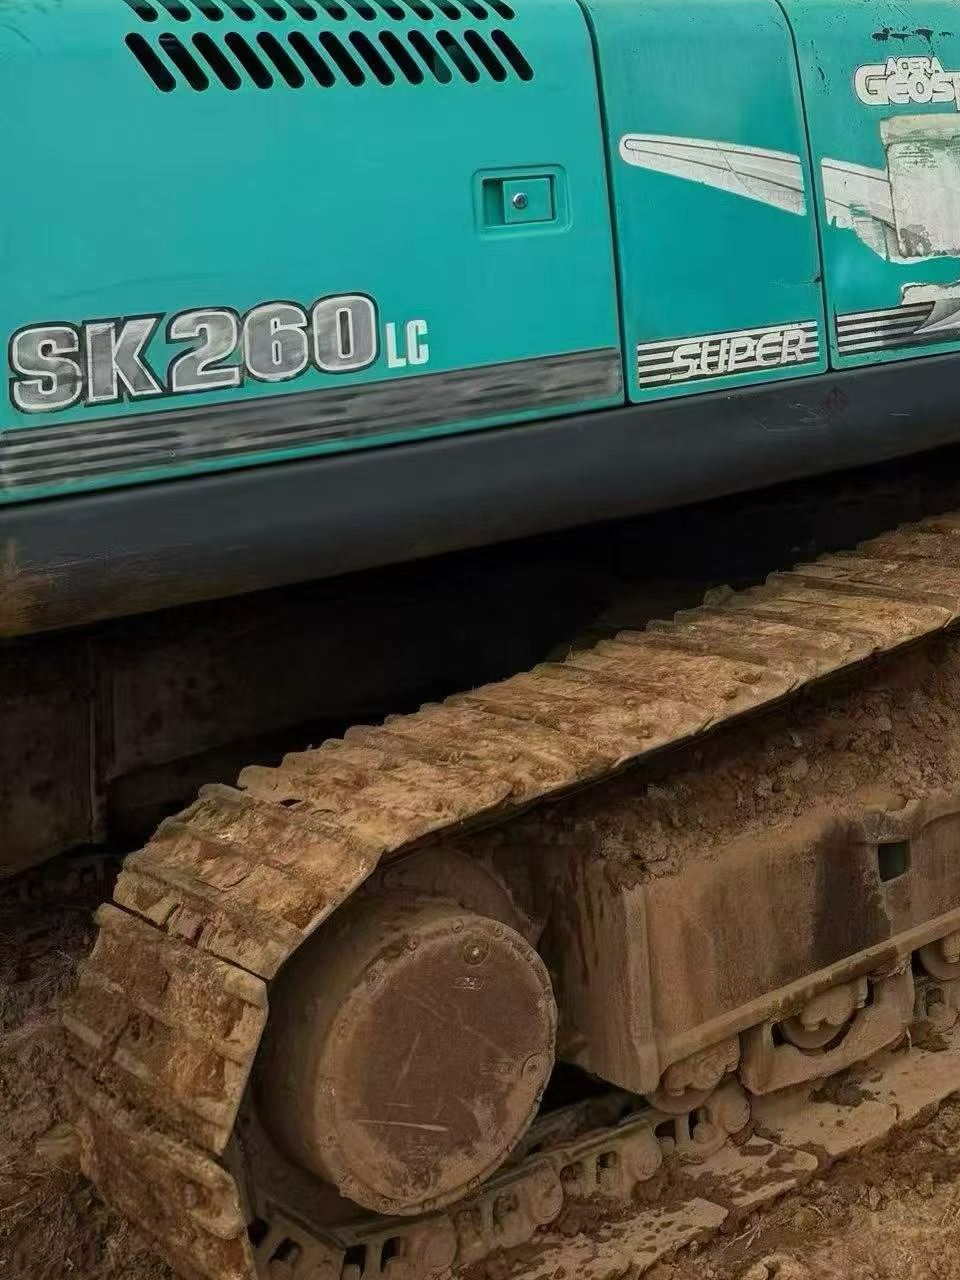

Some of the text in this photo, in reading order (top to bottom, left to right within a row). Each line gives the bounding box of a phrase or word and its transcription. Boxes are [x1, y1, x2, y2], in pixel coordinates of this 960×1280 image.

[8, 292, 431, 414] SK260 LC
[668, 329, 808, 381] SUPER
